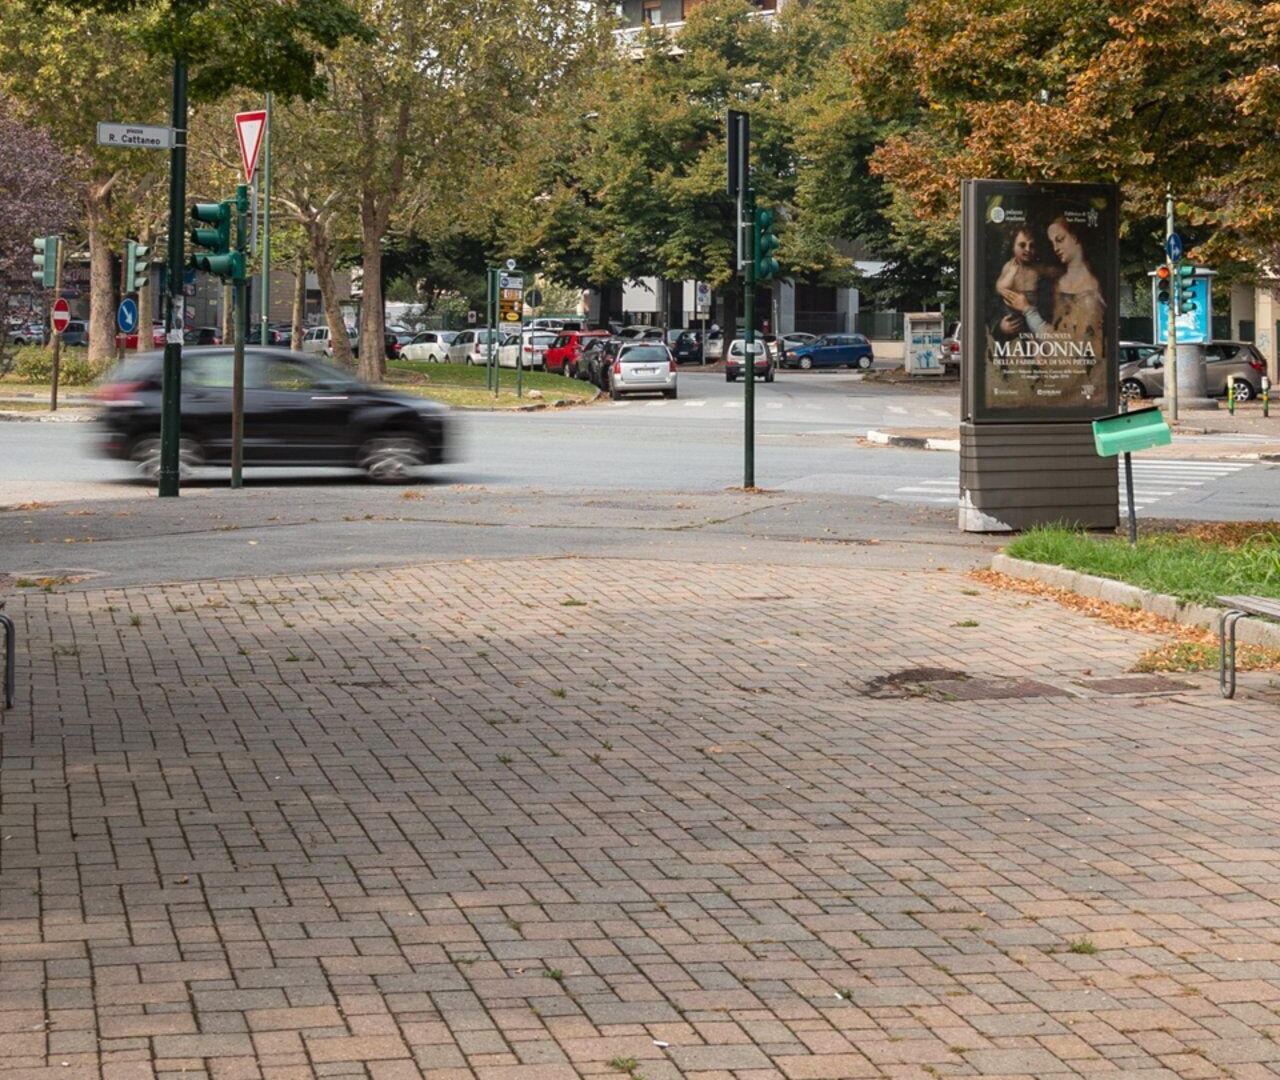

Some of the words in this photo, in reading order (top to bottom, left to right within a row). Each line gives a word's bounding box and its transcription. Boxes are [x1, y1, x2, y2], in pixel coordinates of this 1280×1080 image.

[108, 133, 118, 142] R.
[121, 134, 161, 145] Cattaneo
[993, 340, 1096, 357] MADONNA
